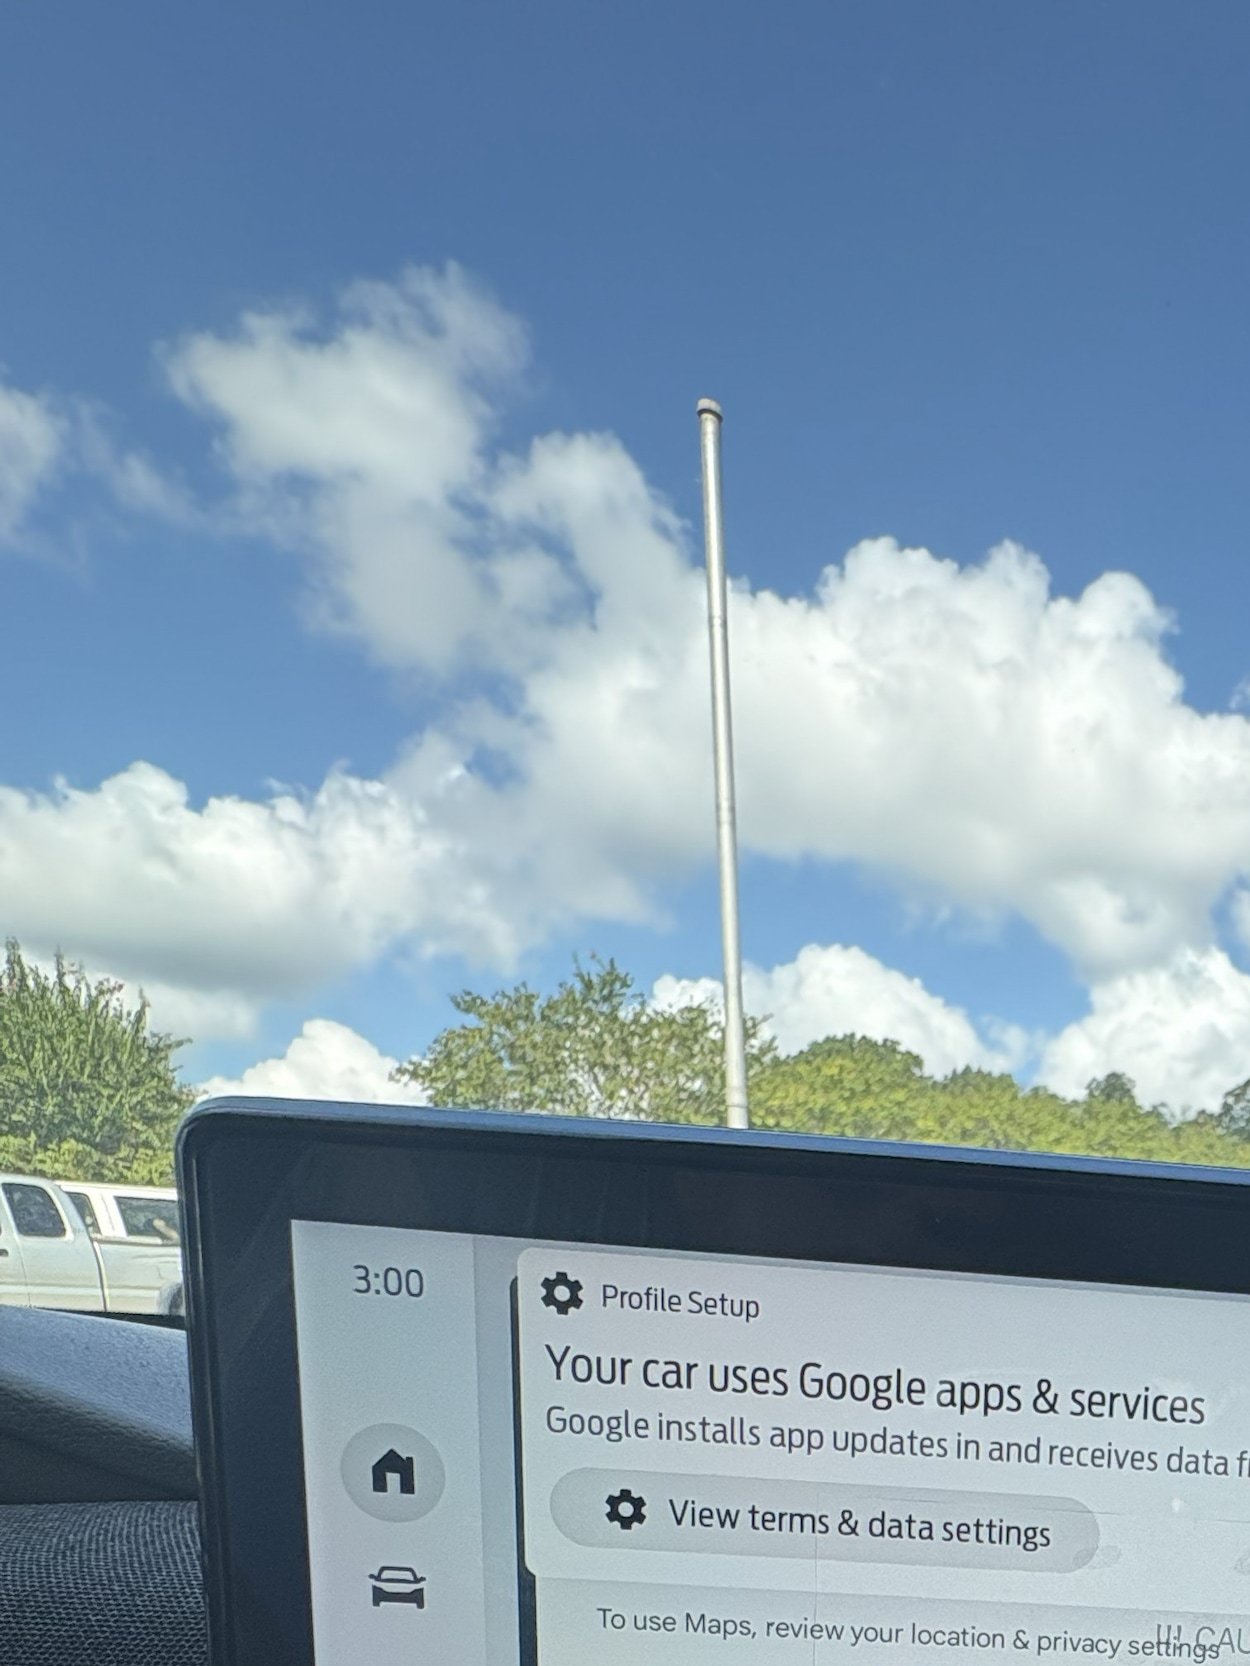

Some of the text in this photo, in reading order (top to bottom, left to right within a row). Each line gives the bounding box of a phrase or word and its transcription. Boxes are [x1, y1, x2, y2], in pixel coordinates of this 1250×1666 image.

[353, 1264, 424, 1298] 3:00
[602, 1283, 760, 1323] Profile Setup
[545, 1343, 1205, 1425] Your car uses Google apps & services
[546, 1405, 650, 1443] Google
[658, 1412, 761, 1446] installs
[769, 1426, 824, 1456] app
[832, 1426, 948, 1458] updates
[956, 1431, 980, 1461] in
[988, 1436, 1041, 1464] and
[1048, 1441, 1158, 1472] receives
[1166, 1445, 1229, 1477] data
[668, 1498, 1051, 1553] View terms & data settings
[596, 1607, 1220, 1664] To use Maps, review your location & privacy settings
